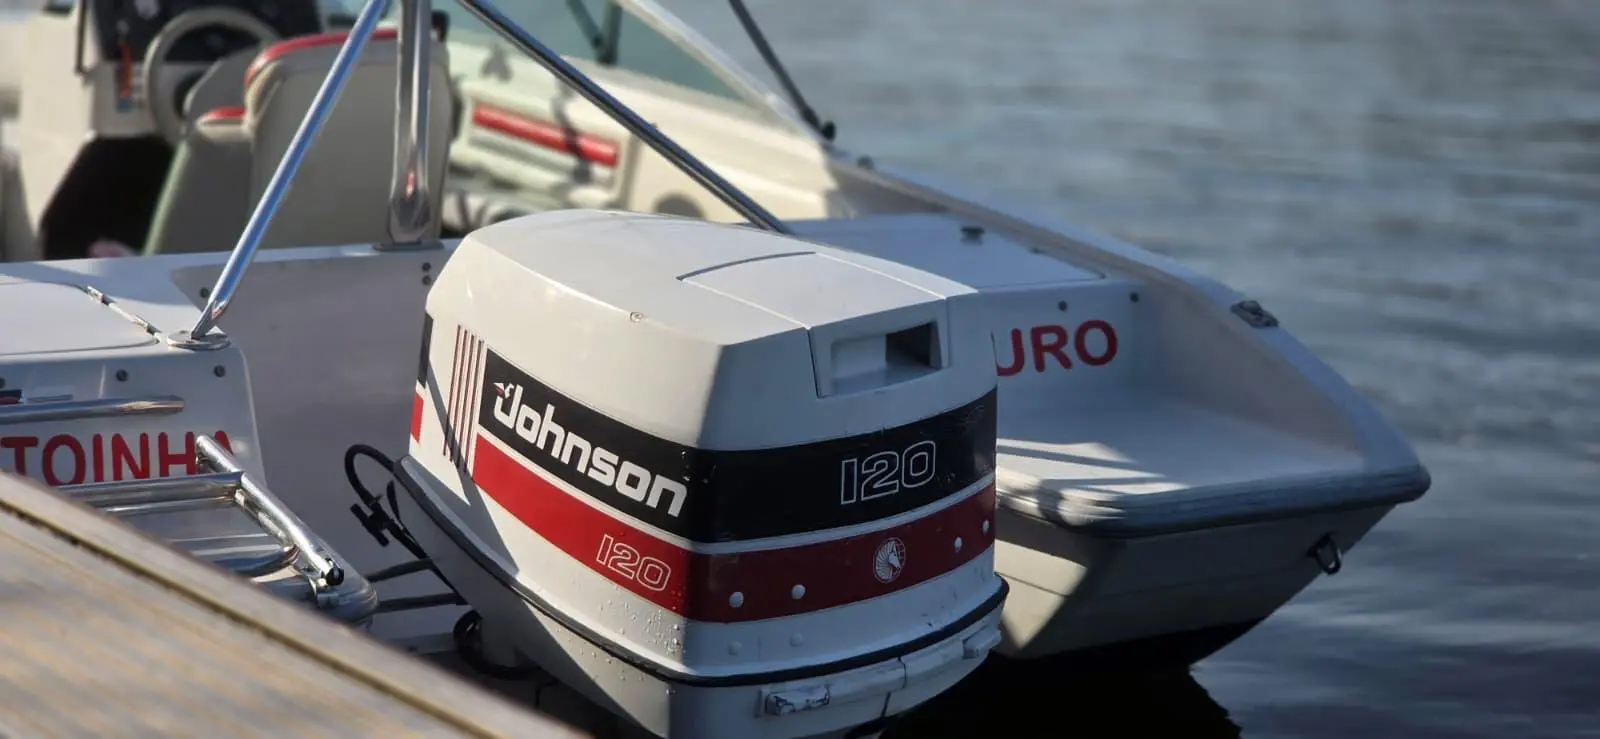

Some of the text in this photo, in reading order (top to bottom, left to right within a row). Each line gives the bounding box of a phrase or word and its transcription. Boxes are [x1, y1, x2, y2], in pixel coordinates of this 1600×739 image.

[493, 381, 688, 518] Johnson
[840, 440, 937, 505] 120
[596, 533, 672, 592] 120
